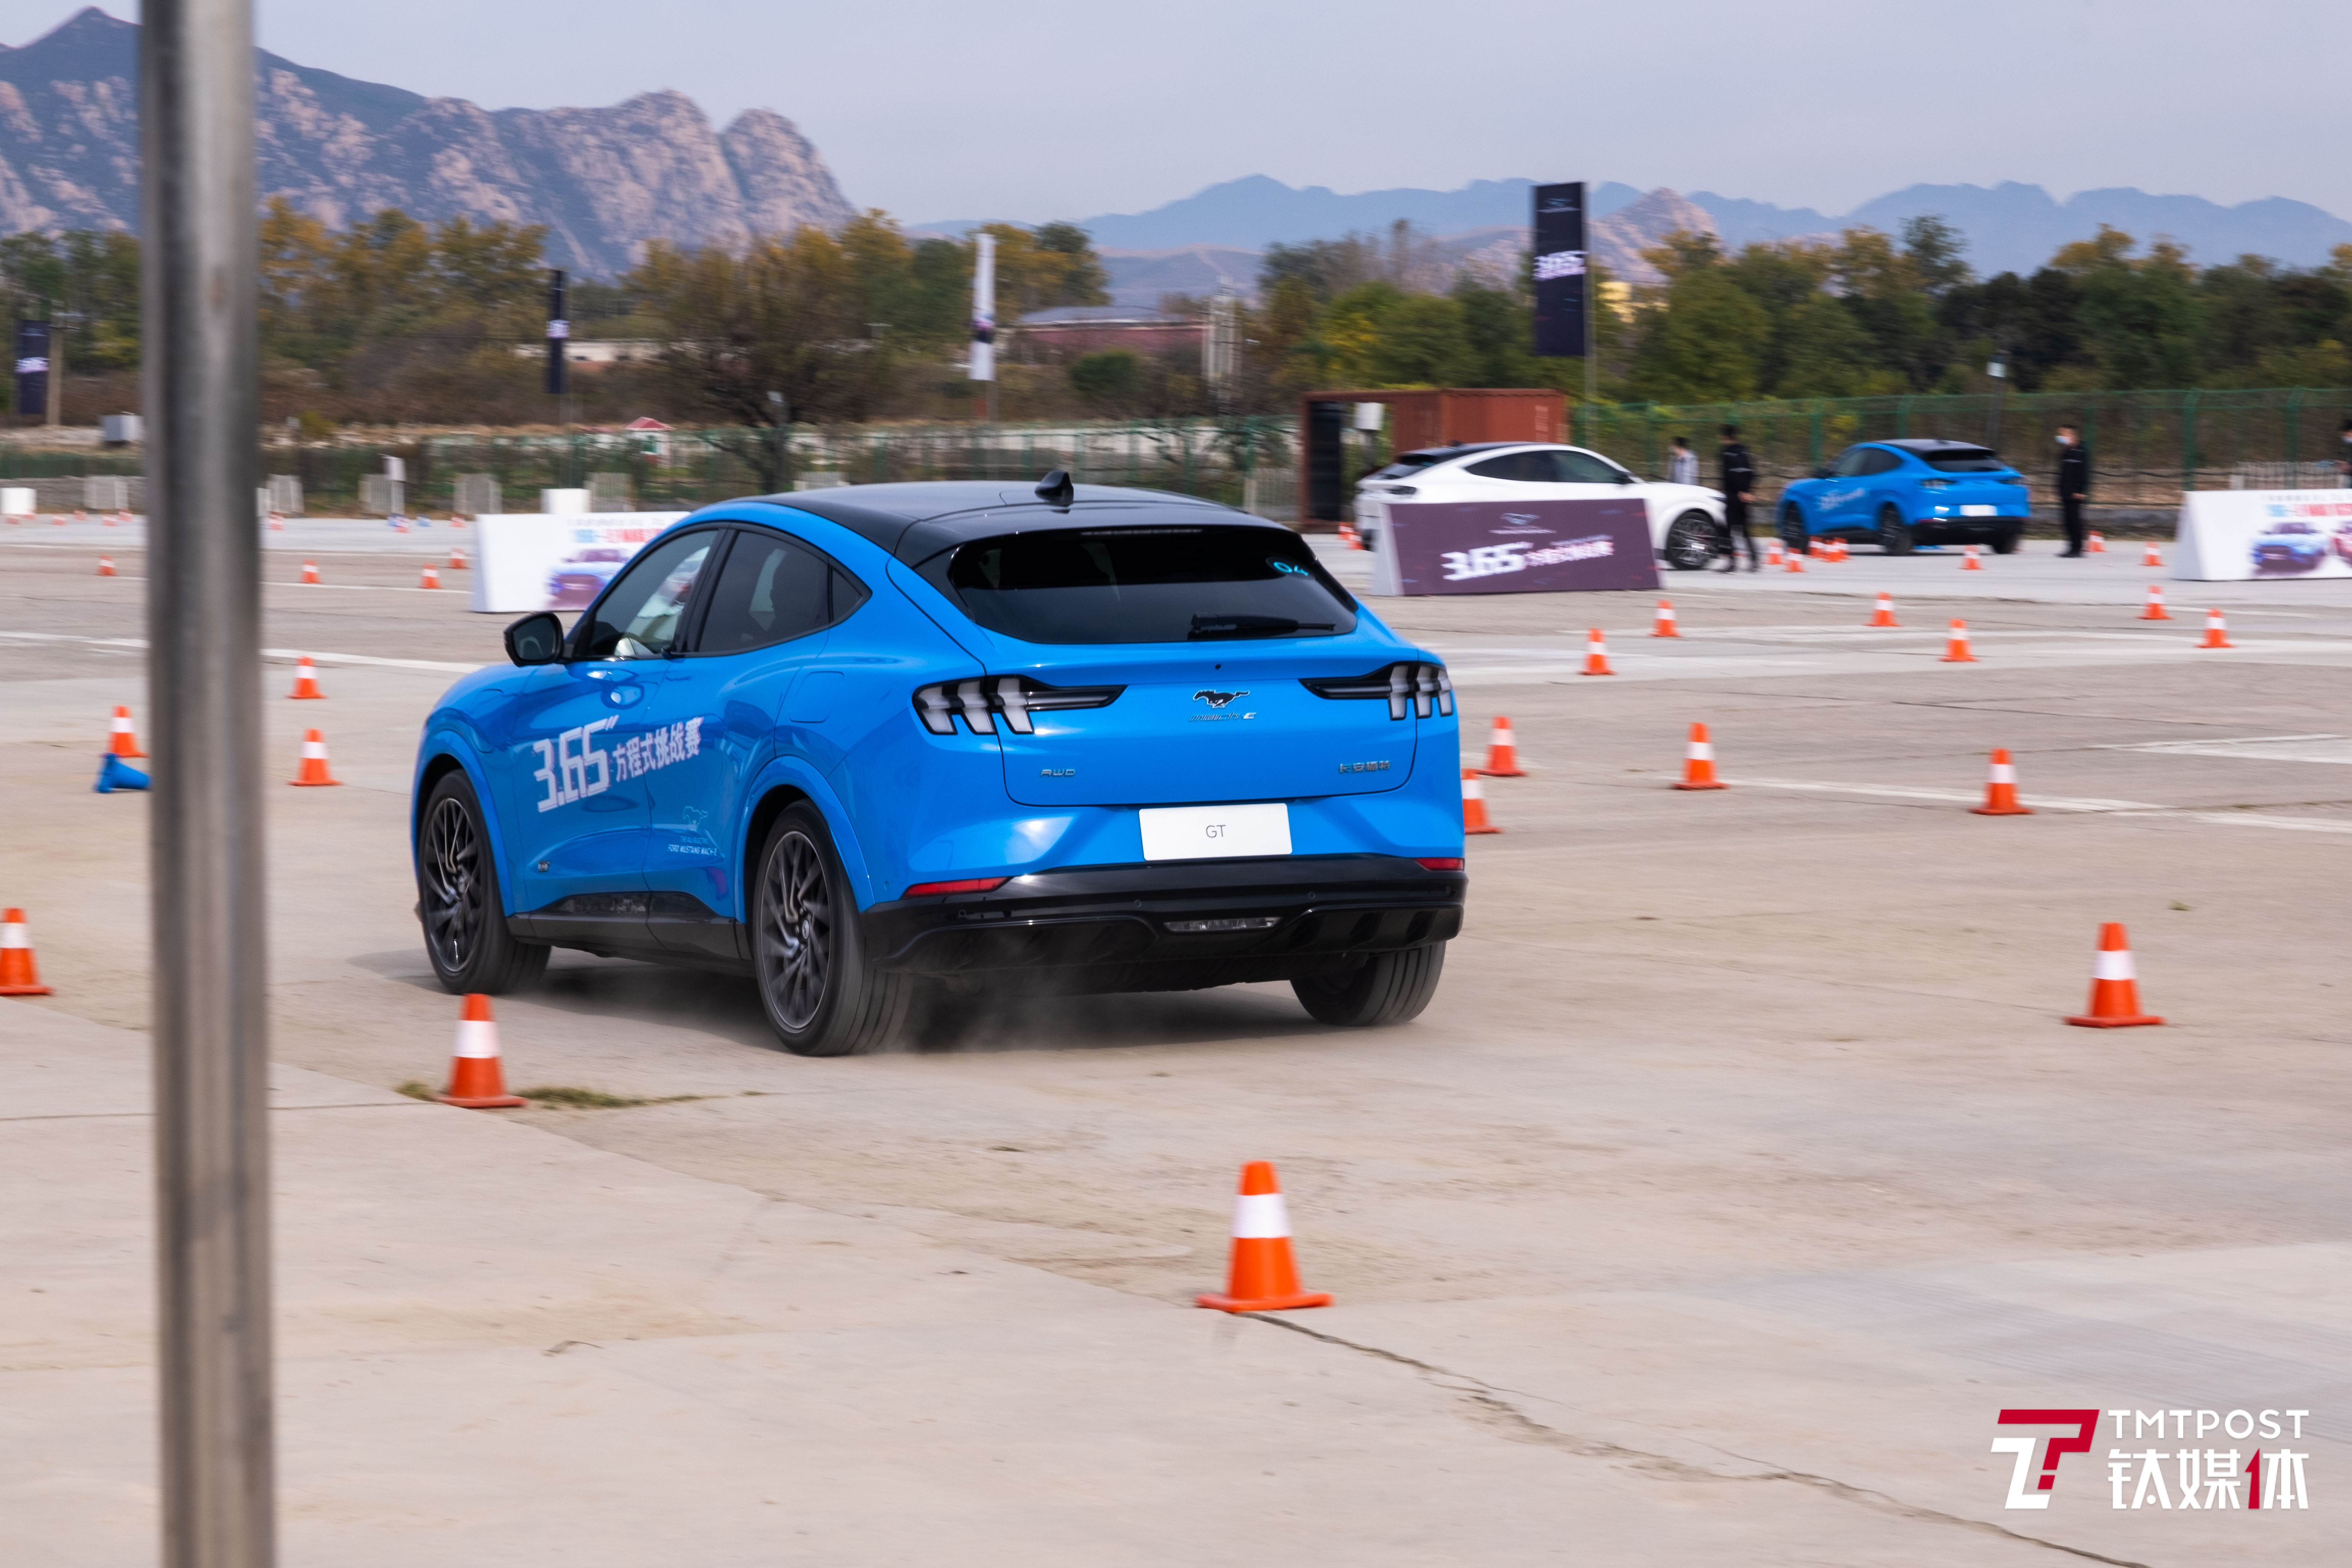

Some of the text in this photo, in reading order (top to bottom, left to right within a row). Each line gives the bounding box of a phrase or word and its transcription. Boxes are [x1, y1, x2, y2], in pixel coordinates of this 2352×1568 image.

[611, 717, 705, 782] 方程式挑战赛
[1206, 825, 1226, 838] GT
